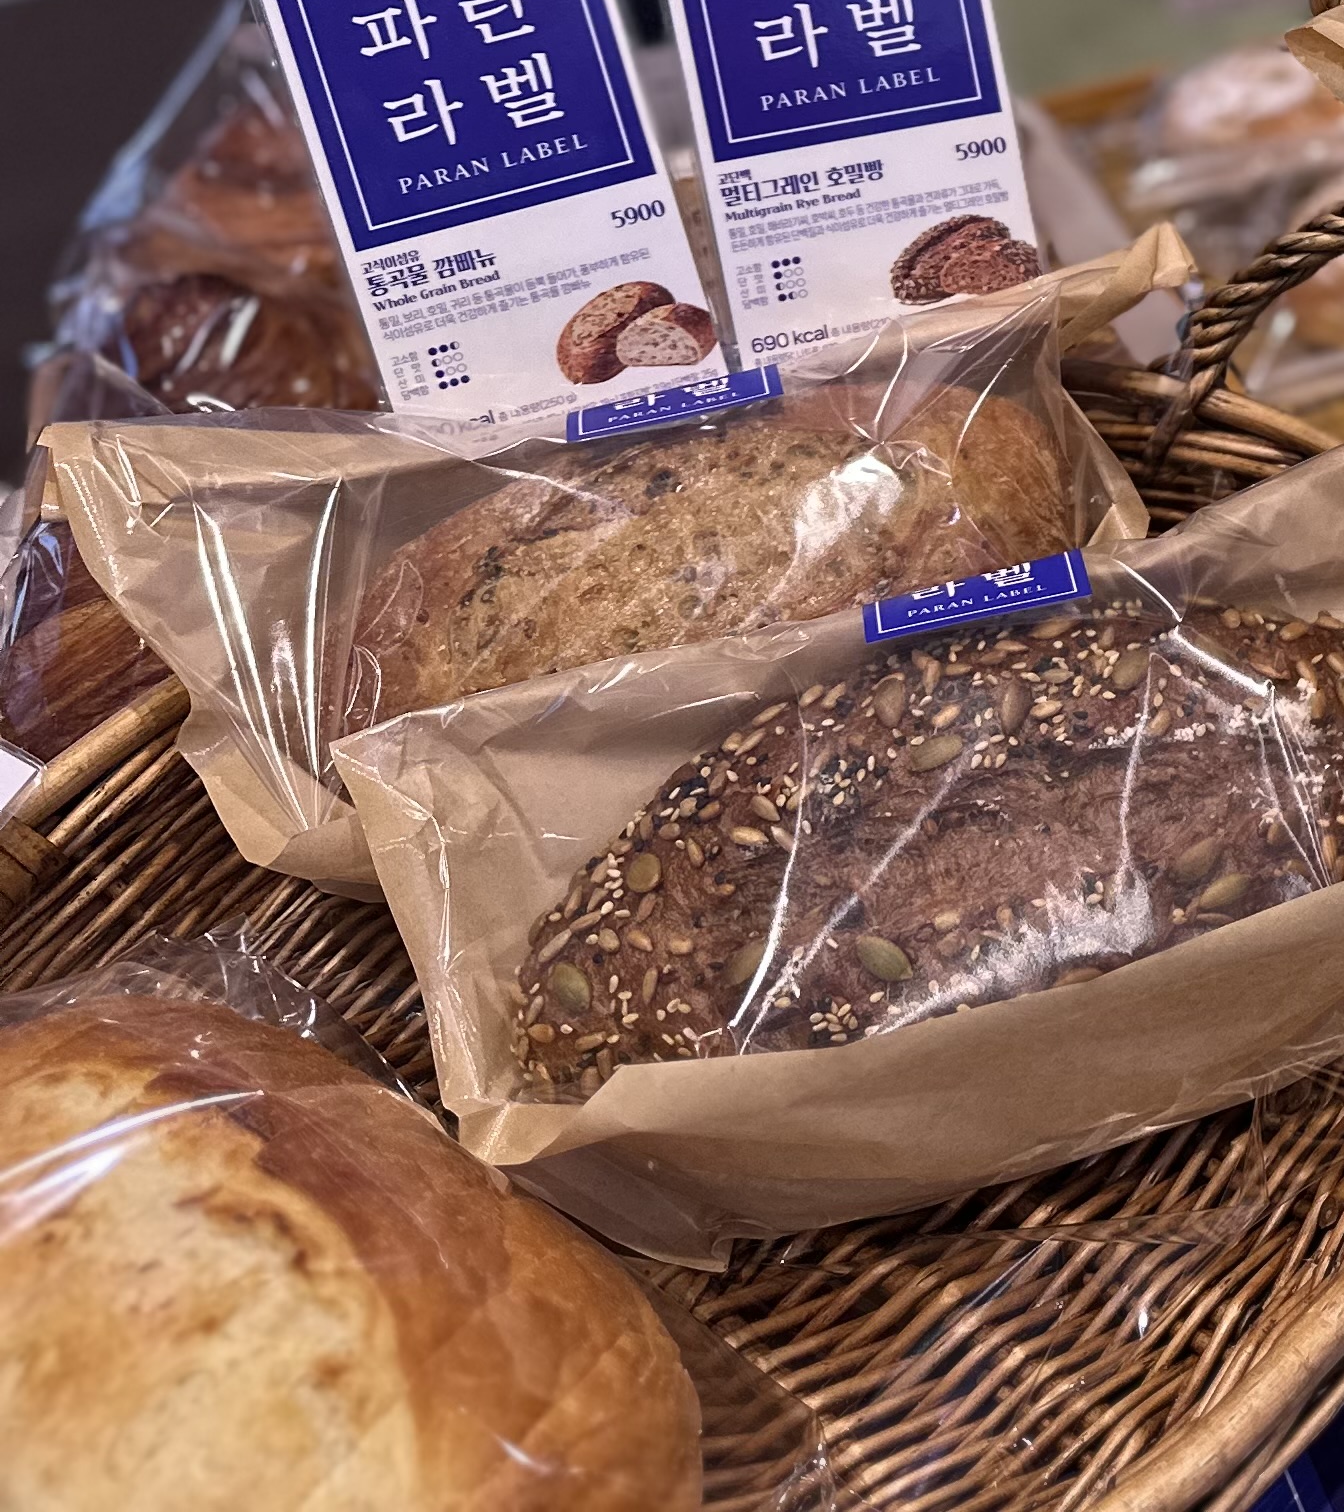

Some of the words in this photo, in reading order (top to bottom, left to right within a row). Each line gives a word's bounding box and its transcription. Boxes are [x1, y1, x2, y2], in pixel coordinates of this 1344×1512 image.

[382, 52, 566, 146] 라벨
[759, 80, 847, 112] PARAN
[860, 65, 941, 94] LABEL
[397, 155, 493, 196] PARAN
[500, 132, 588, 169] LABEL
[954, 135, 1007, 161] 5900
[717, 168, 752, 185] 고단백
[720, 170, 820, 208] 멀티그레인
[824, 158, 885, 189] 호밀빵
[610, 198, 667, 229] 5900
[724, 200, 793, 224] Multigrain
[795, 196, 820, 210] Rye
[821, 188, 861, 205] Bread
[360, 248, 421, 275] 고식이섬유
[364, 261, 430, 298] 통곡물
[431, 243, 498, 280] 깜빠뉴
[372, 291, 418, 312] Whole
[418, 280, 457, 300] Grain
[458, 269, 501, 289] Bread
[750, 331, 790, 354] 690
[791, 323, 829, 345] kcal
[608, 405, 671, 423] PARAN
[681, 392, 741, 409] LABEL
[907, 597, 973, 618] PARAN
[984, 584, 1047, 602] LABEL
